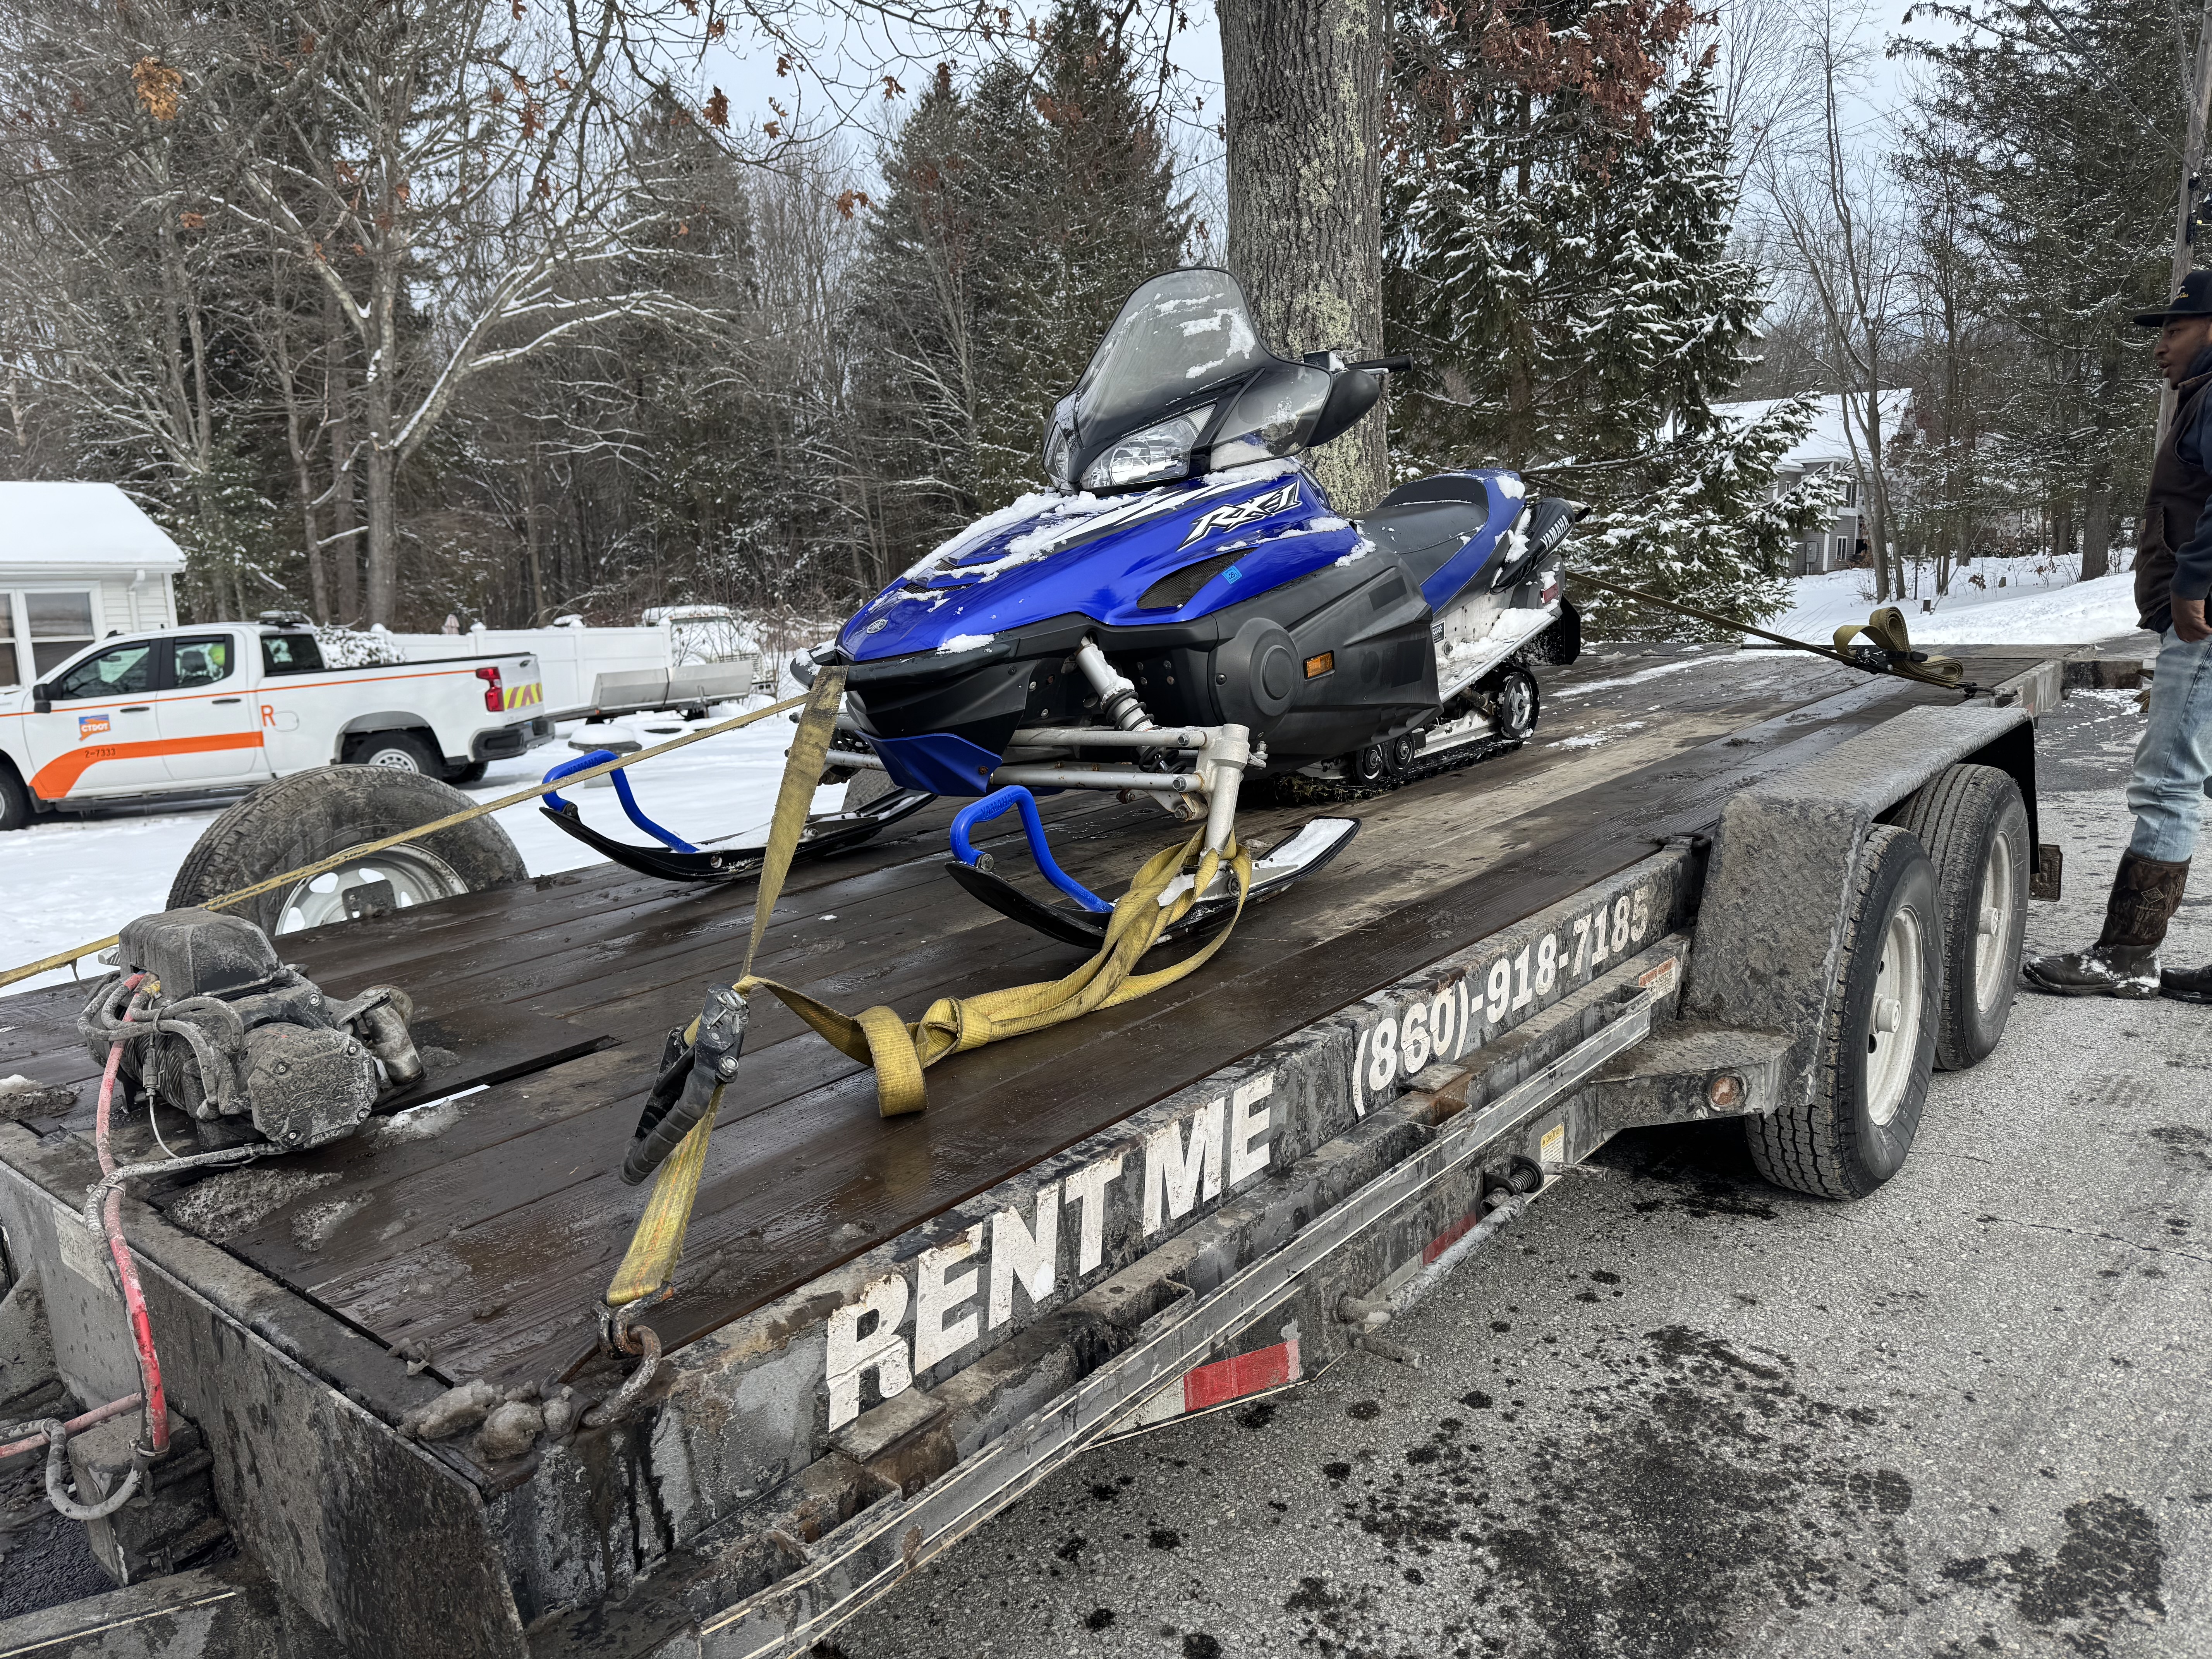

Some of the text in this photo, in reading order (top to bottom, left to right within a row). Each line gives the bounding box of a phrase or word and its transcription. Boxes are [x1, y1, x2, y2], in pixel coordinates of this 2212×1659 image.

[1540, 514, 1570, 551] YAMAHA
[261, 704, 276, 727] R
[85, 747, 116, 758] 2-7333
[567, 757, 599, 775] YAMAHA
[980, 793, 1013, 819] YAMAHA
[1353, 885, 1649, 1117] (860)-918-7185
[1546, 1126, 1562, 1142] CAUTION
[826, 1072, 1274, 1434] RENT ME
